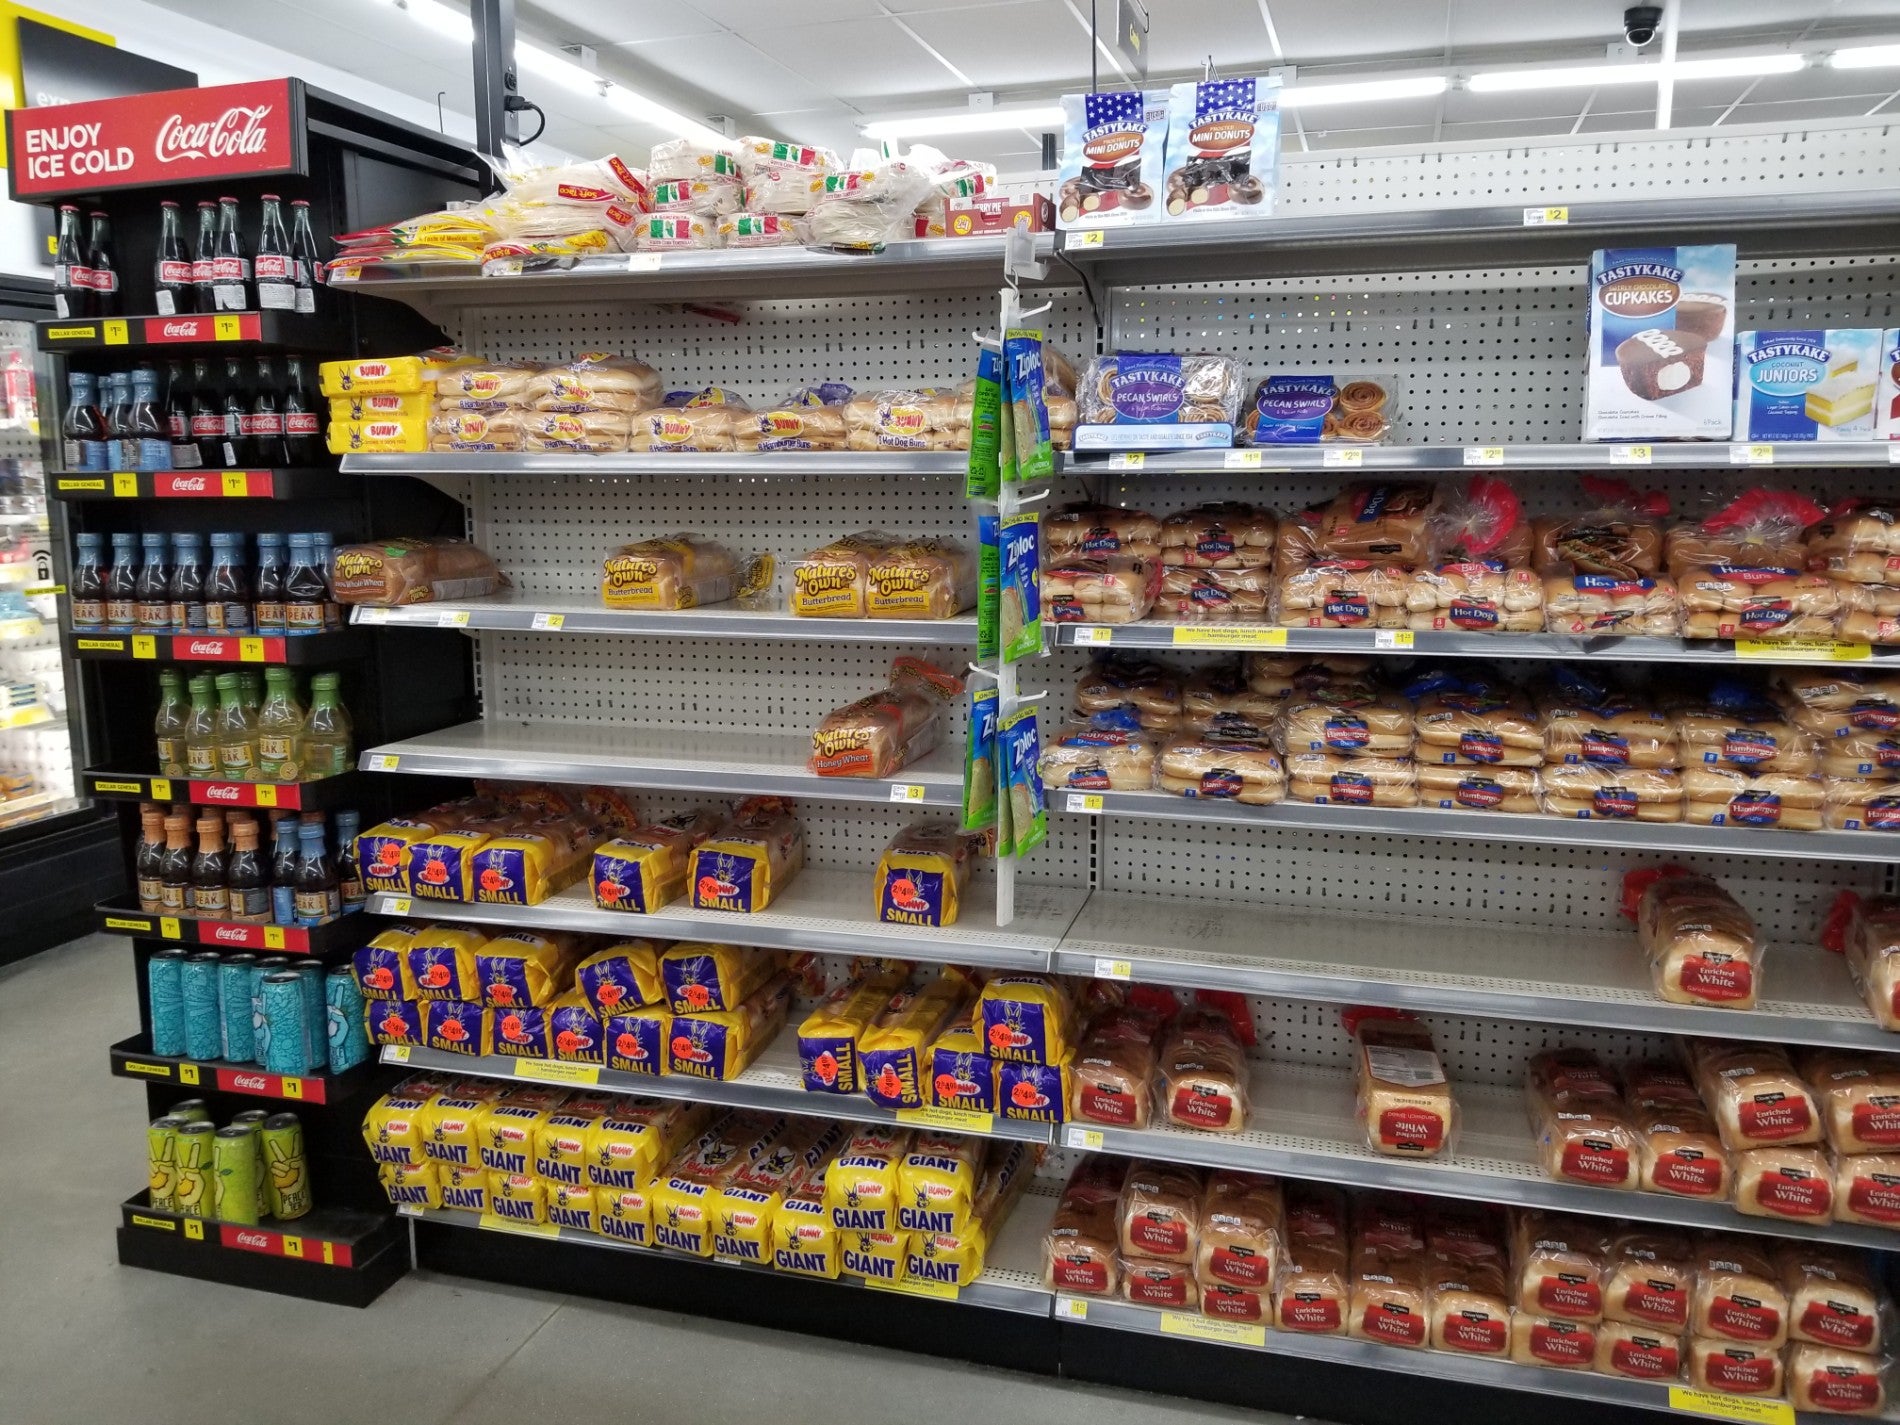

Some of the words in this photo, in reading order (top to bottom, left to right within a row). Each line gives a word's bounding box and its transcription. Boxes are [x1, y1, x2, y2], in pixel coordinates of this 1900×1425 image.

[1190, 111, 1258, 128] TASTYKAKE
[26, 123, 102, 153] ENJOY
[156, 104, 272, 163] Coca-Cola
[1084, 122, 1147, 142] TASTYKAKE
[1192, 133, 1213, 143] MINI
[1215, 130, 1250, 140] DONUTS
[1086, 146, 1105, 155] MINI
[1107, 138, 1140, 152] DONUTS
[28, 155, 65, 179] ICE
[70, 148, 134, 176] COLD
[1598, 265, 1681, 284] TASTYKAKE
[1605, 290, 1673, 305] CUPKAKES
[163, 322, 198, 337] Coca-Cola
[1748, 345, 1830, 364] TASTYKAKE
[359, 364, 388, 376] BUNNY
[1016, 351, 1041, 379] Ziploc
[1112, 372, 1184, 388] TASTYKAKE
[1757, 369, 1817, 382] JUNIORS
[475, 380, 499, 391] BUNNY
[1261, 385, 1332, 395] TASTYKAKE
[372, 395, 399, 408] BUNNY
[1117, 393, 1145, 403] PECAN
[1146, 393, 1178, 402] SWIRLS
[1263, 400, 1292, 408] PECAN
[1293, 400, 1326, 408] SWIRLS
[775, 417, 800, 430] BUNNY
[370, 425, 397, 436] BUNNY
[895, 438, 909, 448] Dog
[909, 439, 925, 448] Buns
[1129, 455, 1139, 464] $2
[1633, 448, 1646, 458] $3
[171, 477, 205, 491] Coca-Cola
[1007, 534, 1035, 565] Ziploc
[343, 563, 370, 579] Own
[604, 559, 657, 576] Nature's
[796, 563, 856, 582] Nature's
[613, 570, 644, 587] Own
[869, 566, 930, 584] Nature's
[608, 586, 654, 597] Butterbread
[808, 575, 842, 595] Own
[880, 576, 914, 595] Own
[802, 593, 851, 606] Butterbread
[874, 594, 925, 606] Butterbread
[288, 610, 313, 620] PEAK
[1327, 605, 1343, 614] Hot
[1344, 606, 1364, 616] Dog
[1454, 608, 1472, 617] Hot
[1473, 610, 1493, 620] Dog
[1766, 612, 1788, 622] Dog
[190, 641, 224, 655] Coca-Cola
[813, 730, 871, 749] Nature's
[1326, 730, 1367, 739] Hamburger
[824, 739, 856, 758] Own
[1014, 728, 1037, 760] Ziploc
[1726, 744, 1774, 757] Hamburger
[817, 760, 842, 768] Honey
[842, 754, 869, 764] Wheat
[207, 786, 239, 800] Coca-Cola
[1332, 786, 1370, 796] Hamburger
[1733, 805, 1778, 816] Hamburger
[415, 883, 459, 899] SMALL
[479, 890, 522, 905] SMALL
[699, 897, 746, 913] SMALL
[886, 908, 933, 927] SMALL
[216, 926, 248, 941] Coca-Cola
[1700, 968, 1735, 978] Enriched
[1698, 974, 1735, 987] White
[432, 1036, 475, 1056] SMALL
[498, 1042, 543, 1057] SMALL
[990, 1044, 1040, 1064] SMALL
[612, 1056, 655, 1076] SMALL
[674, 1059, 718, 1080] SMALL
[838, 1042, 853, 1091] SMALL
[184, 1068, 194, 1078] $1
[234, 1075, 266, 1090] Coca-Cola
[287, 1082, 296, 1092] $1
[1094, 1096, 1123, 1107] Enriched
[1188, 1099, 1217, 1109] Enriched
[1093, 1102, 1123, 1115] White
[1187, 1105, 1217, 1118] White
[1756, 1108, 1791, 1118] Enriched
[1756, 1116, 1794, 1126] White
[610, 1145, 634, 1156] BUNNY
[481, 1147, 526, 1174] GIANT
[839, 1157, 888, 1171] GIANT
[1580, 1154, 1613, 1164] Enriched
[1578, 1161, 1613, 1174] White
[588, 1166, 635, 1190] GIANT
[857, 1184, 883, 1195] BUNNY
[492, 1196, 534, 1220] GIANT
[832, 1207, 886, 1230] GIANT
[900, 1207, 954, 1234] GIANT
[189, 1223, 199, 1234] $1
[600, 1215, 645, 1242] GIANT
[1144, 1226, 1173, 1236] Enriched
[236, 1232, 267, 1248] Coca-Cola
[1143, 1232, 1173, 1245] White
[288, 1241, 298, 1252] $1
[1556, 1288, 1588, 1298] Enriched
[1554, 1294, 1588, 1306] White
[1295, 1307, 1324, 1315] Enriched
[1727, 1310, 1762, 1322] Enriched
[1295, 1313, 1326, 1323] White
[1725, 1314, 1761, 1330] White
[1458, 1331, 1491, 1343] White
[1460, 1326, 1491, 1335] Enriched
